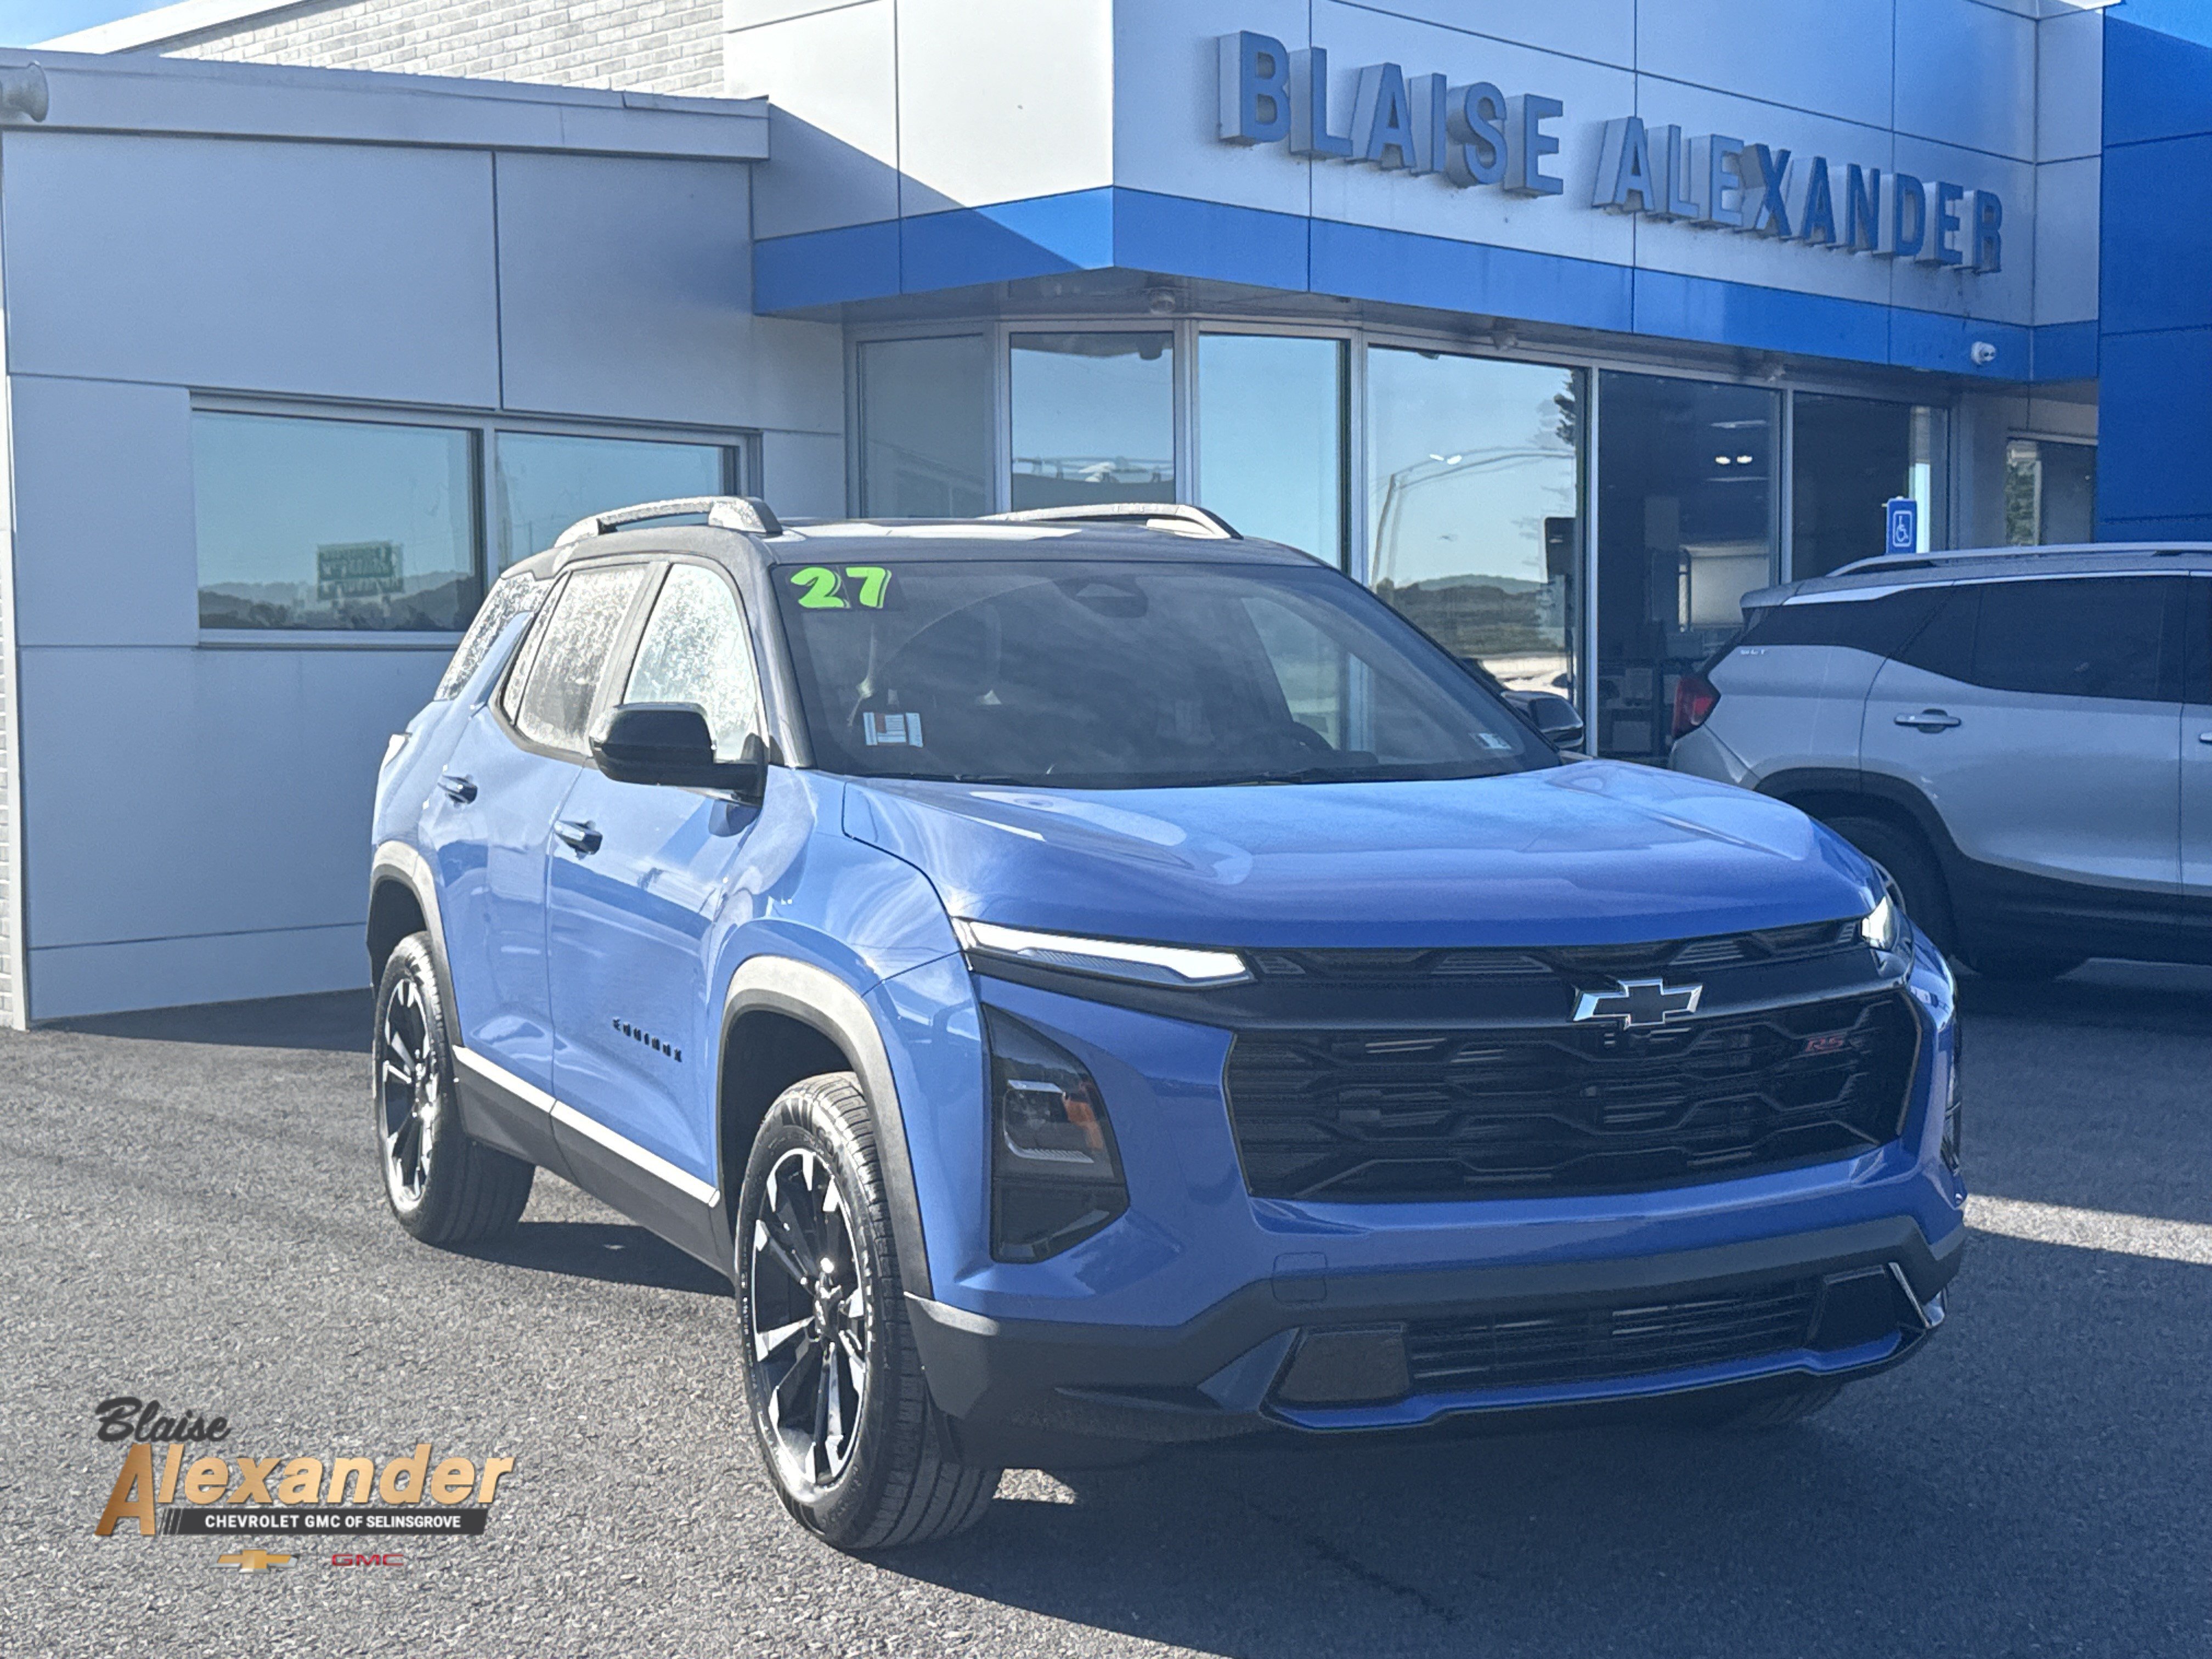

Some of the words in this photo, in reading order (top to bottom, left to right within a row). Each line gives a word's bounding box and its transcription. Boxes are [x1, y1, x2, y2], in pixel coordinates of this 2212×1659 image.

[1234, 30, 1564, 195] BLAISE
[1596, 116, 2004, 273] ALEXANDER
[791, 566, 892, 609] 27
